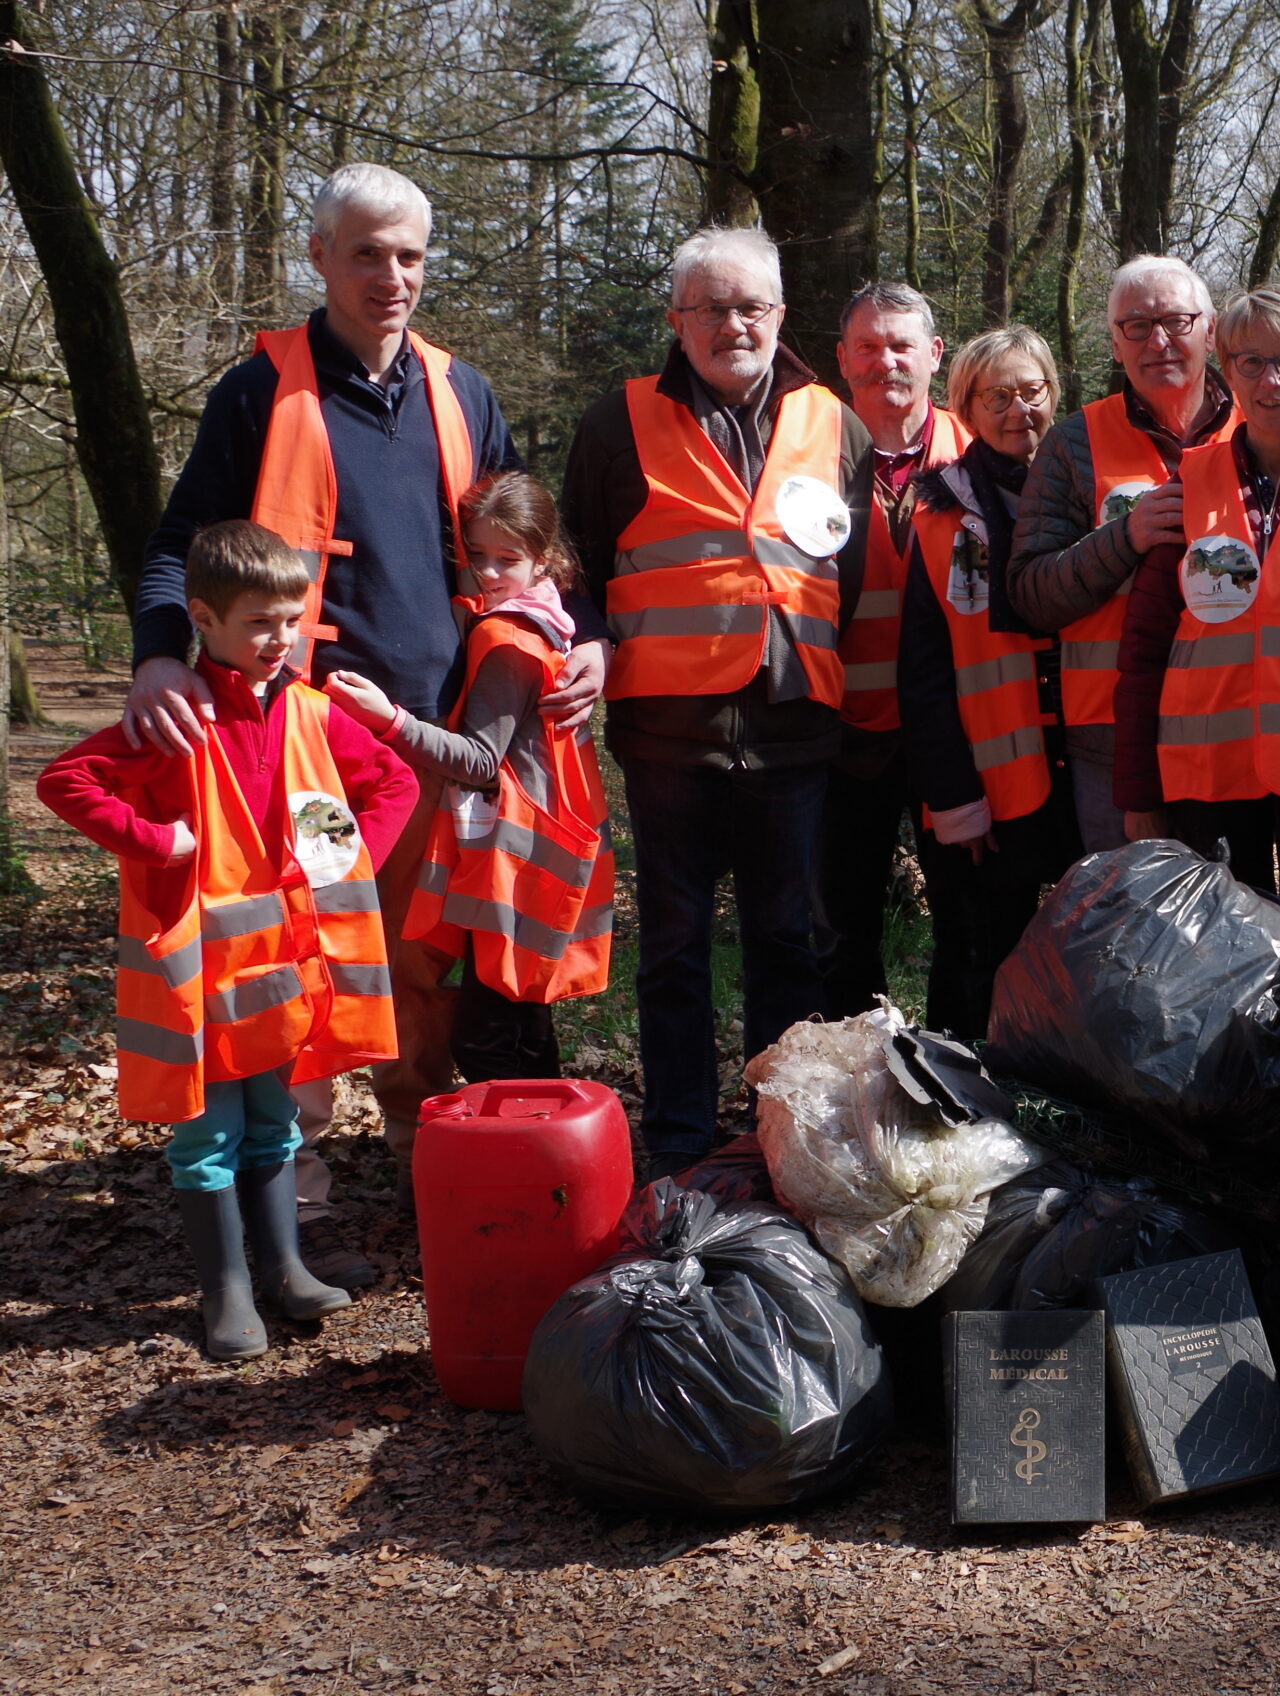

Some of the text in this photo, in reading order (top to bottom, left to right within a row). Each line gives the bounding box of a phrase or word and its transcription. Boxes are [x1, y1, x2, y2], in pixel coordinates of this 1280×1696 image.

[1162, 1327, 1217, 1345] ENCYCLOPÉDIE
[1165, 1337, 1221, 1357] LAROUSSE
[989, 1348, 1069, 1361] LAROUSSE
[1195, 1361, 1201, 1369] 2
[988, 1366, 1069, 1380] MÉDICAL
